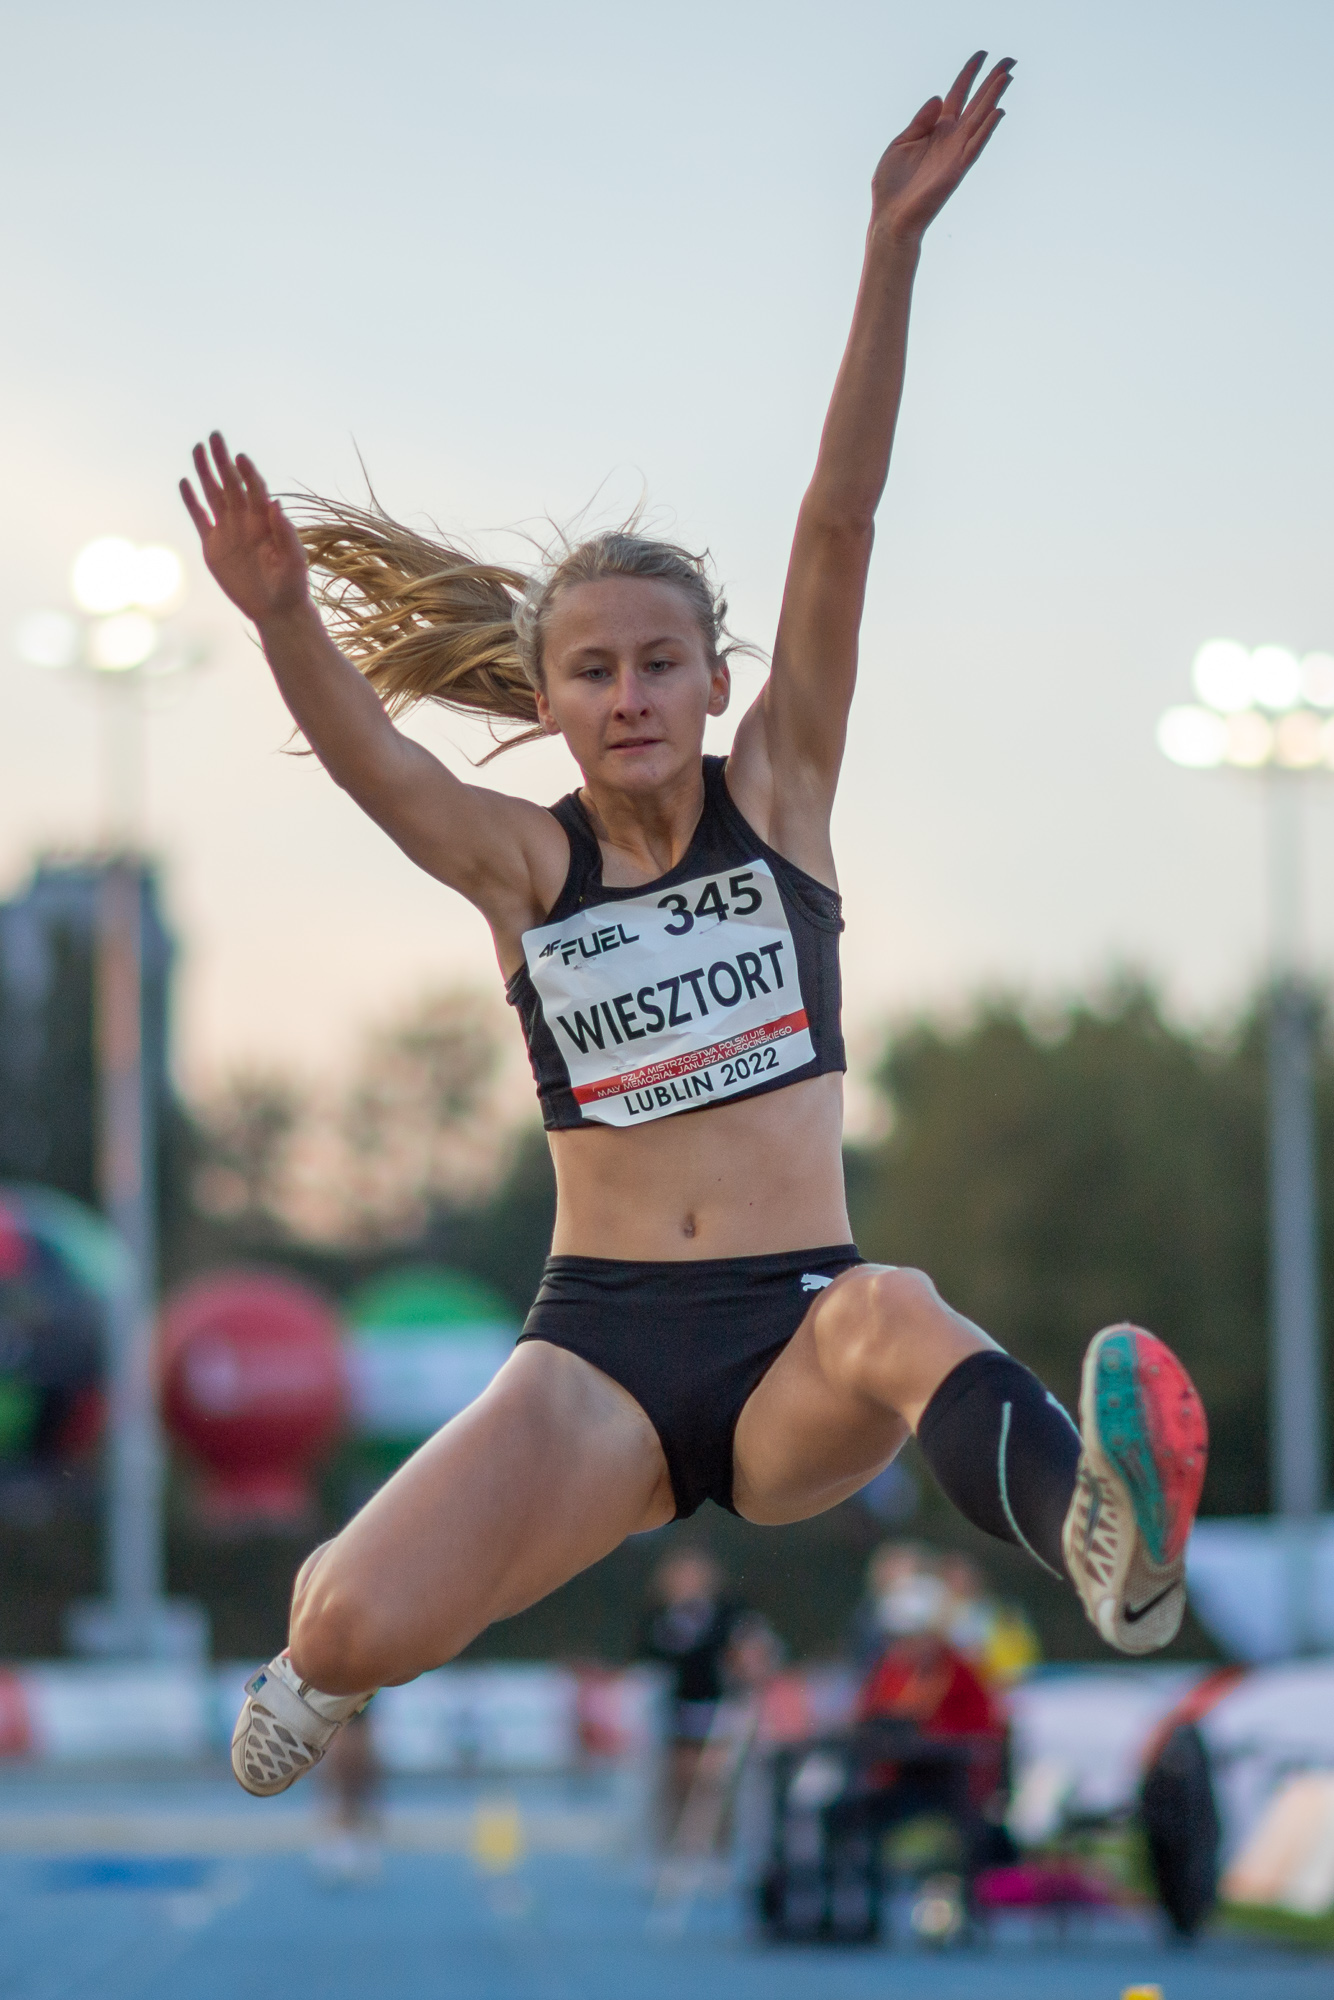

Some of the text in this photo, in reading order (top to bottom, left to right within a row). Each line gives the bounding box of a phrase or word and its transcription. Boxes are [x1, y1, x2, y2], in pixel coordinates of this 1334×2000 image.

[657, 872, 763, 935] 345
[561, 923, 640, 966] FUEL
[556, 940, 784, 1054] WIESZTORT
[620, 1027, 766, 1083] PZLA MISTRZOSTWA POLSKI U16
[624, 1047, 780, 1116] LUBLIN 2022
[678, 1053, 724, 1074] JANUSZA
